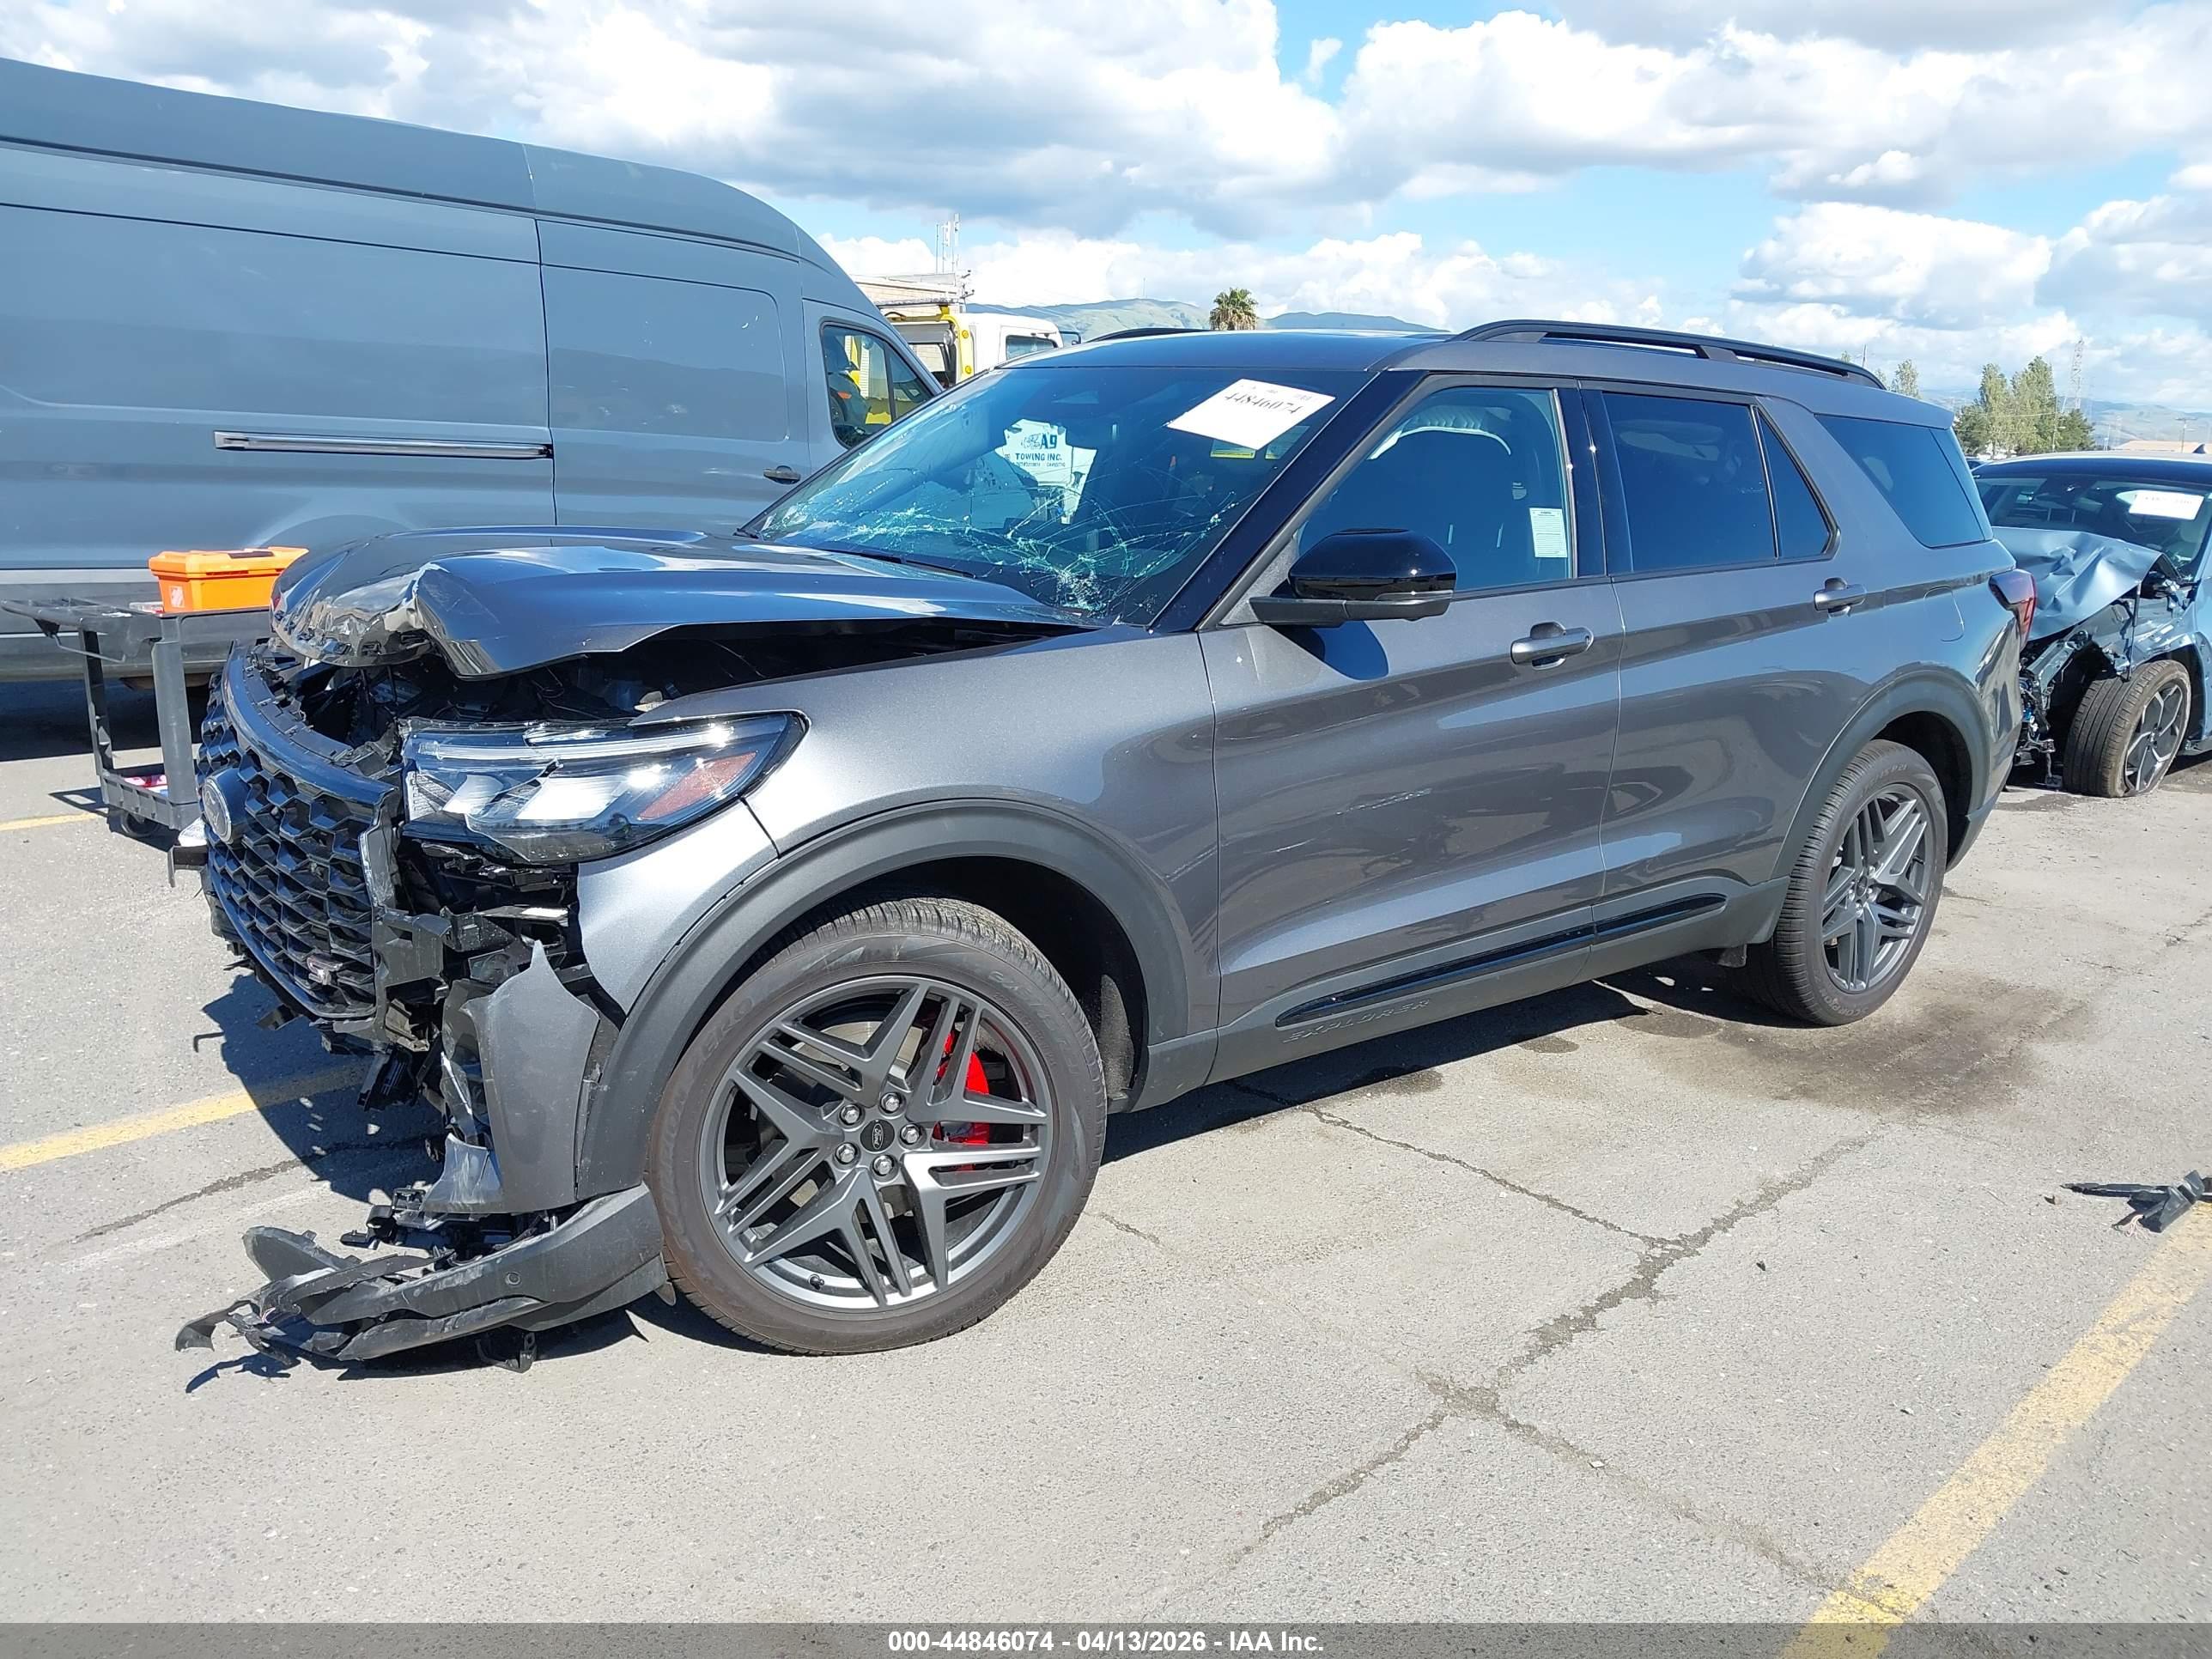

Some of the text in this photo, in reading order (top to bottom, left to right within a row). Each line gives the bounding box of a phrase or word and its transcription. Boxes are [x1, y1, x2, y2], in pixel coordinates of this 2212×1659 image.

[1040, 433, 1057, 449] A9
[1015, 453, 1045, 461] TOWING
[1283, 1000, 1430, 1042] EXPLORER
